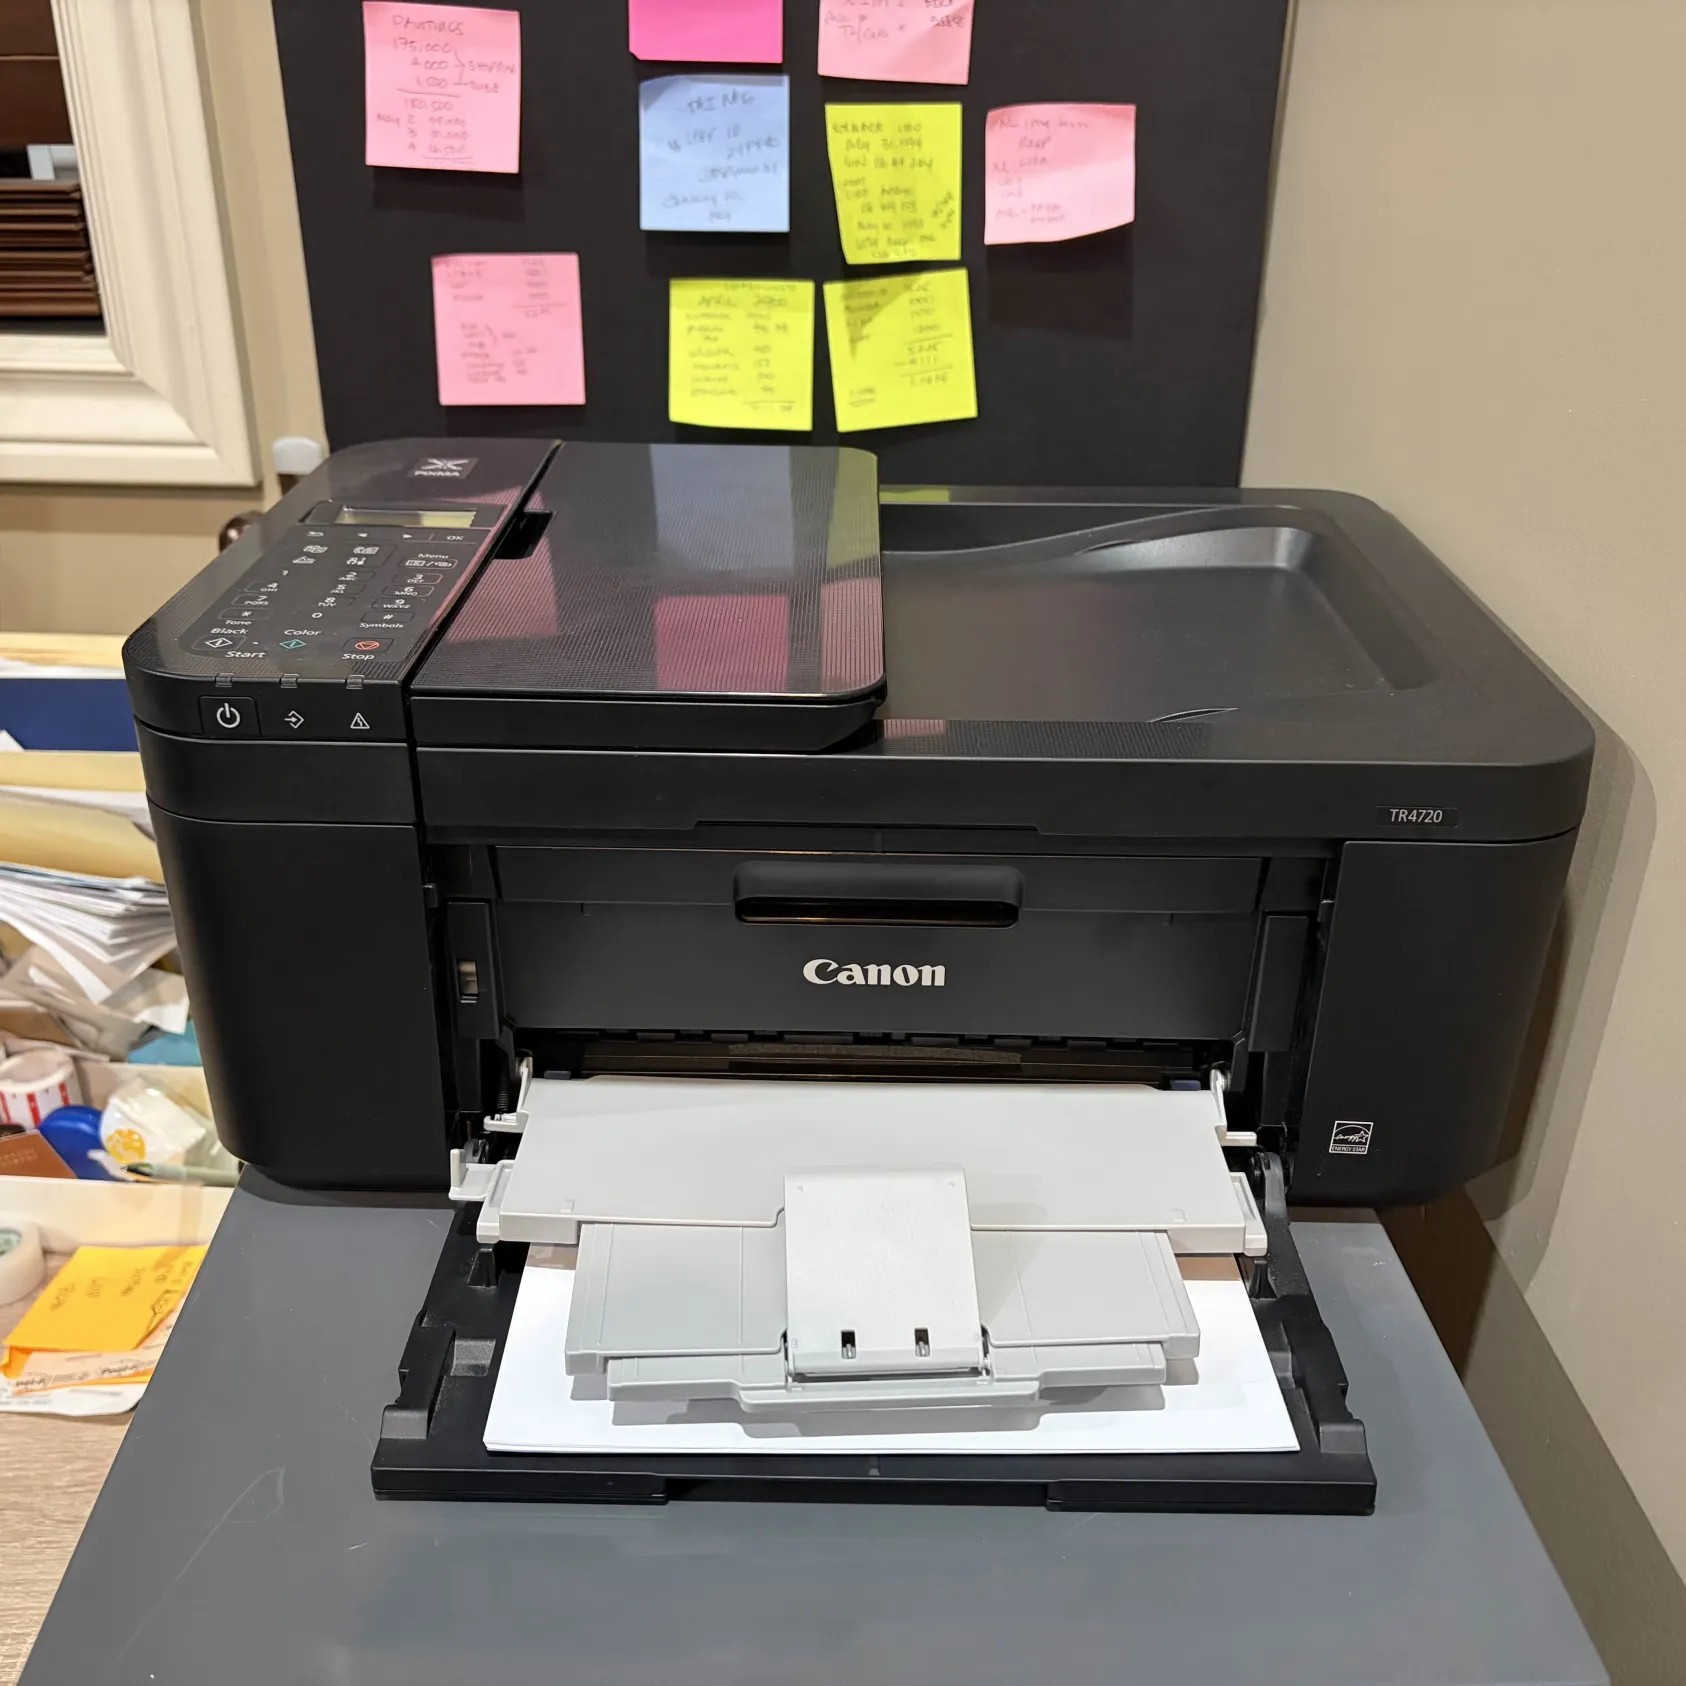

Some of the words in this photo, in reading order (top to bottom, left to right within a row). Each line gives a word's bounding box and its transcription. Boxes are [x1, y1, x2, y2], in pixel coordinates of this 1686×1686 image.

[342, 653, 375, 661] Stop
[1389, 809, 1443, 823] TR4720
[803, 958, 946, 986] Canon
